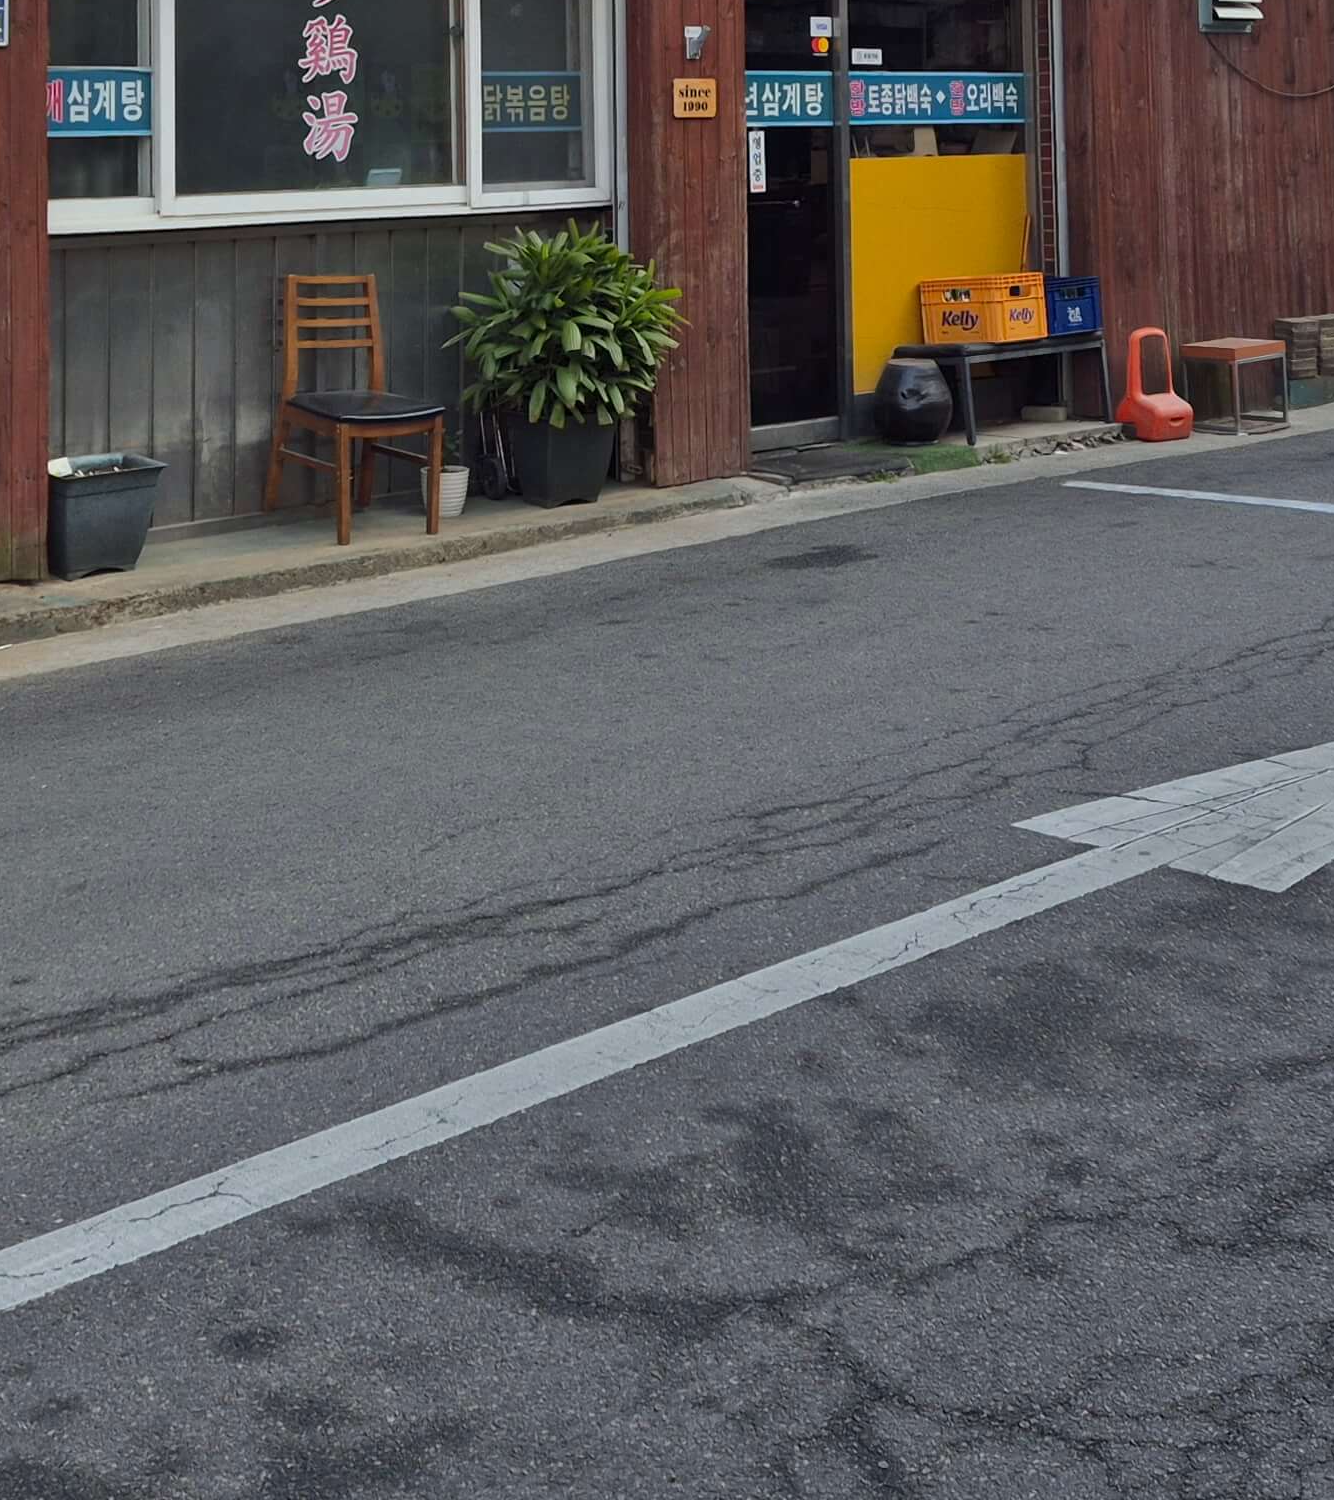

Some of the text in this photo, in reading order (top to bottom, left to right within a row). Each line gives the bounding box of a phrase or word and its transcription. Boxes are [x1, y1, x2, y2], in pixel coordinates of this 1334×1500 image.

[678, 84, 712, 98] since
[867, 83, 932, 116] 토종닭백숙
[966, 82, 1018, 115] 오리백숙
[483, 84, 571, 123] 닭볶음탕
[941, 310, 979, 331] Kelly
[1009, 308, 1035, 325] Kelly
